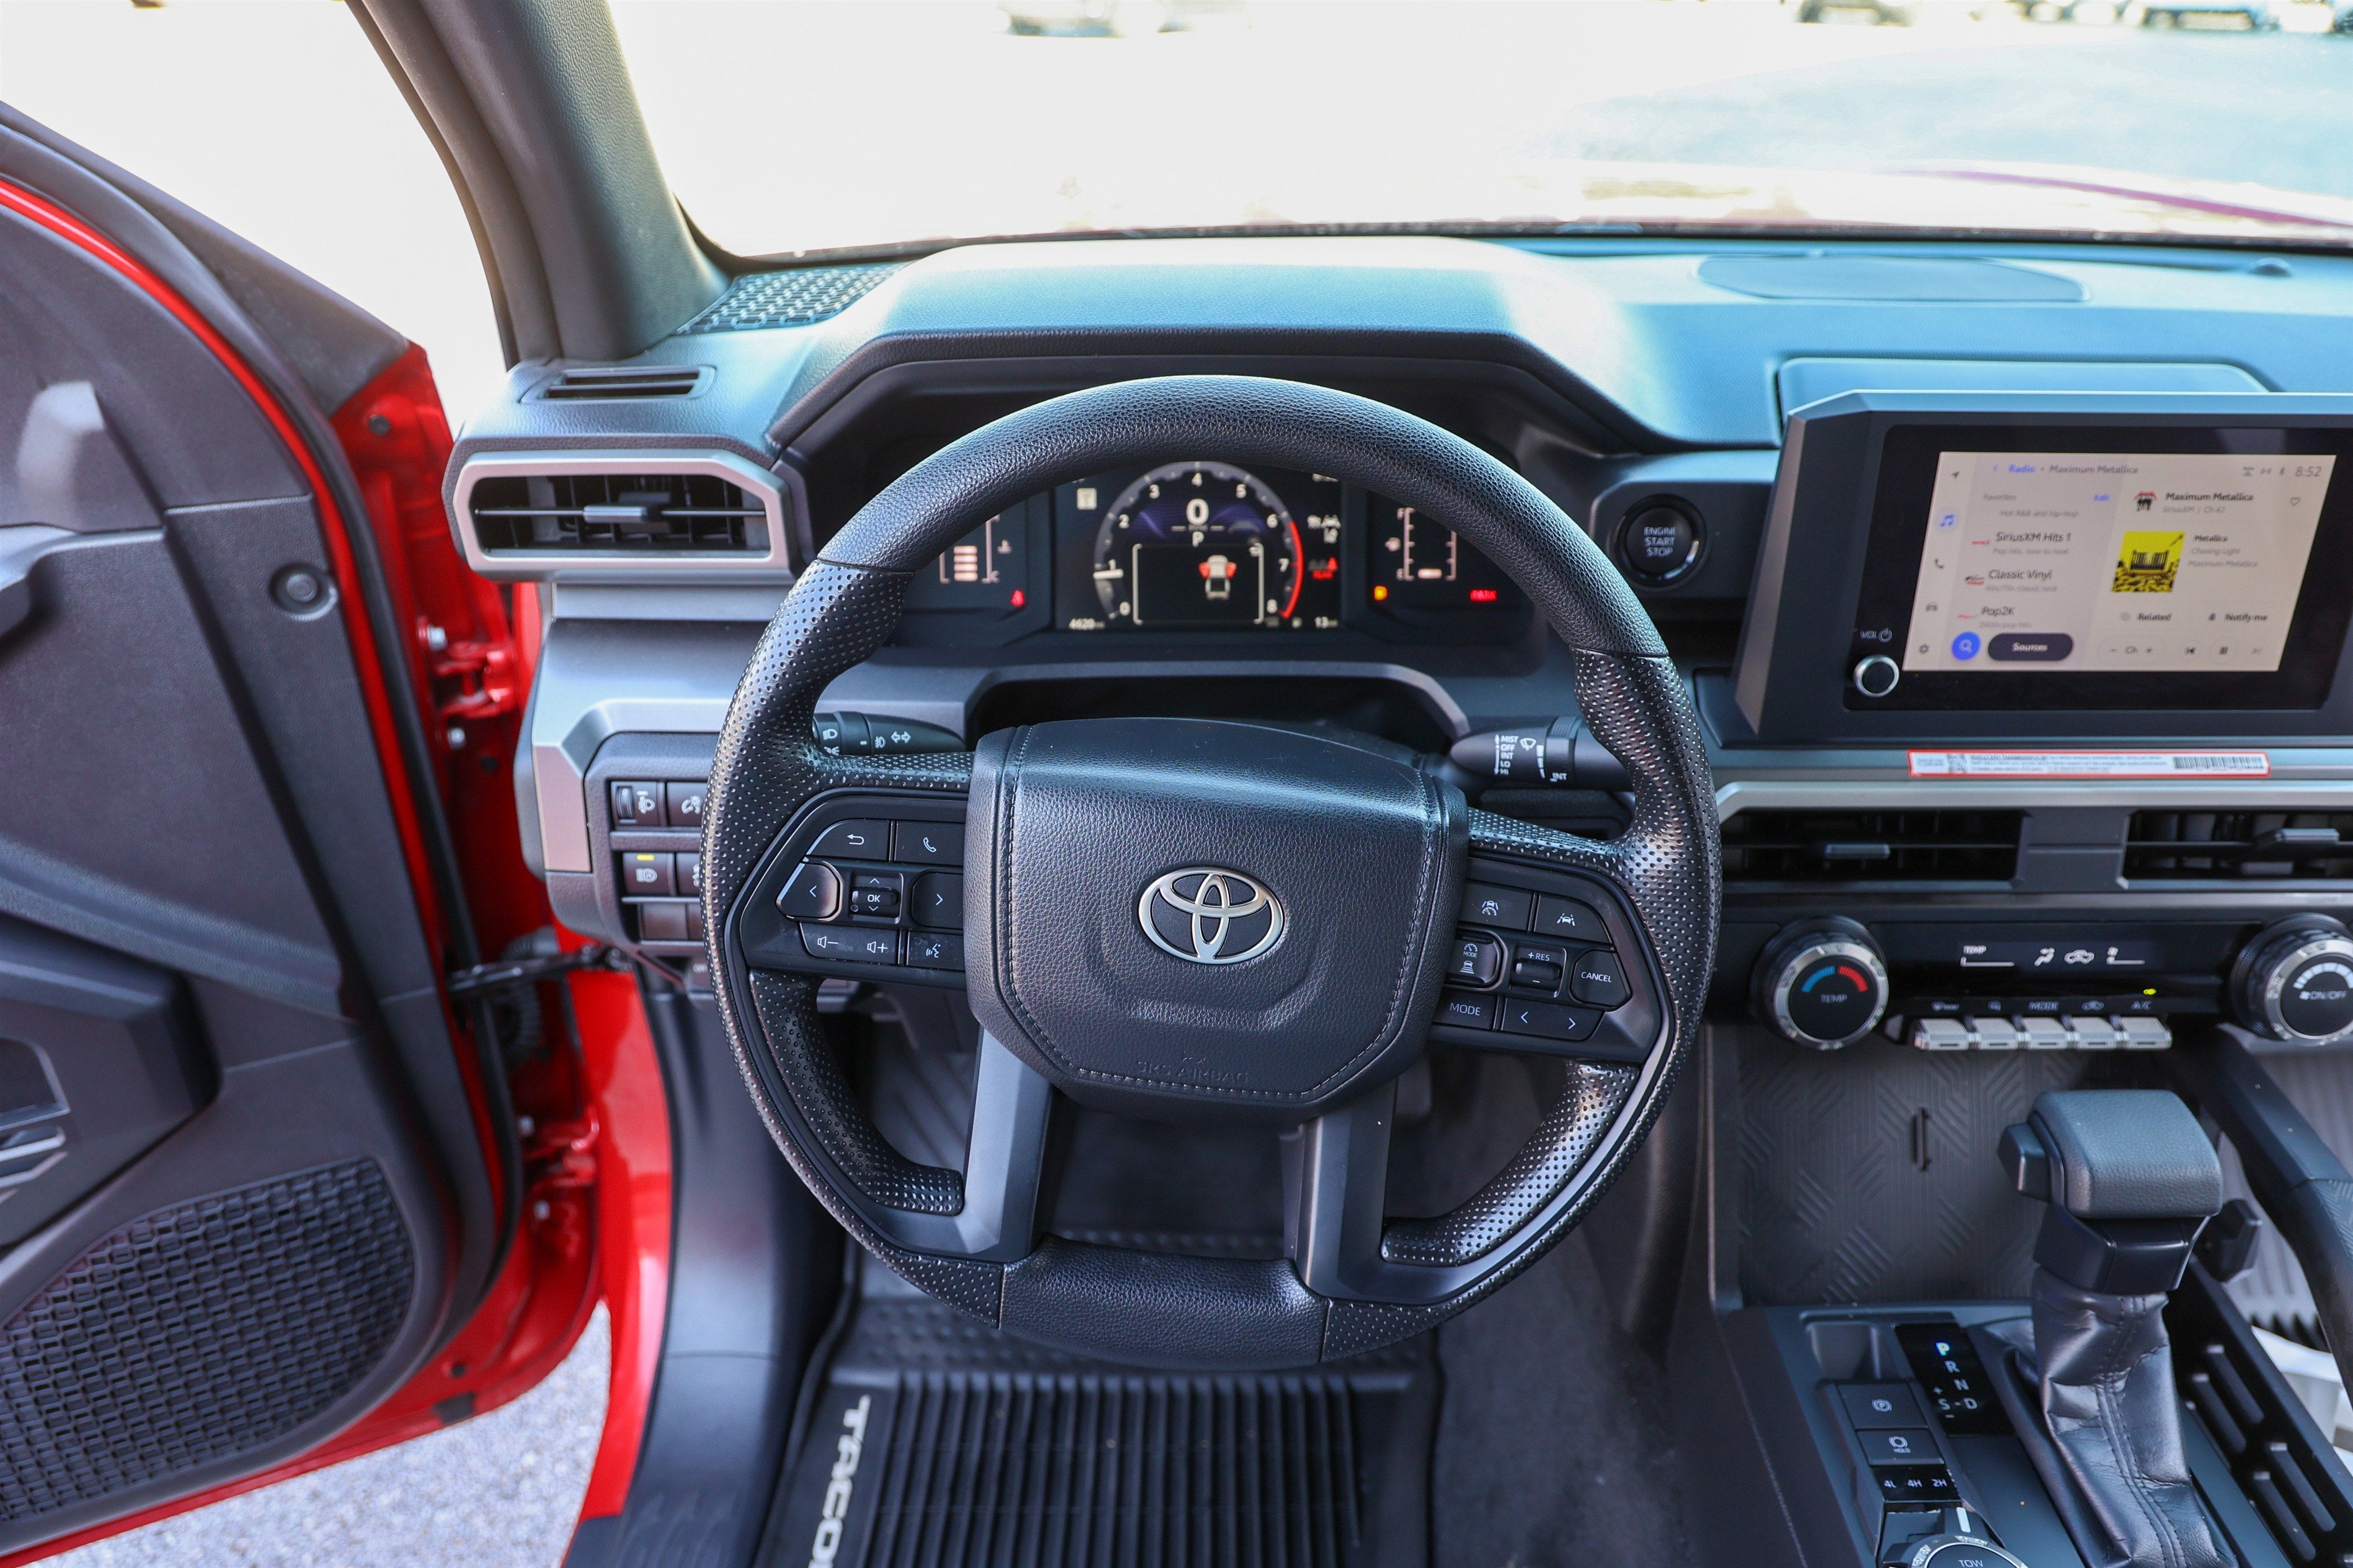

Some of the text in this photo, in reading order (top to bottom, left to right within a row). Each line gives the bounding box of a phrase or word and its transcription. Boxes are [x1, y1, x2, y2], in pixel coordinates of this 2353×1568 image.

[2008, 465, 2139, 474] Radio Maximum Metallica
[2295, 466, 2323, 477] 8:52
[1191, 472, 1203, 487] 4
[1149, 484, 1160, 499] 3
[1236, 484, 1247, 499] 5
[2165, 492, 2254, 501] Maximum Metallica
[1186, 498, 1209, 526] 0
[1118, 513, 1130, 529] 2
[1266, 513, 1278, 529] 6
[1644, 527, 1677, 536] ENGINE
[1996, 531, 2040, 542] SiriusXM
[2044, 532, 2063, 542] Hits
[1191, 531, 1205, 547] P
[1644, 536, 1675, 546] START
[1646, 547, 1673, 557] STOP
[1279, 558, 1290, 573] 7
[1988, 569, 2053, 581] Classic Vinyl
[1119, 601, 1131, 616] 0
[1982, 606, 2015, 617] Pop2K
[2138, 613, 2171, 621] Related
[2224, 613, 2251, 623] Notify
[2012, 642, 2049, 652] Sources
[1500, 735, 1519, 743] MIST
[1500, 744, 1515, 752] OFF
[1500, 752, 1514, 760] INT
[1552, 772, 1568, 781] INT
[867, 894, 881, 903] OK
[1963, 945, 1987, 955] TEMP
[1580, 971, 1613, 983] CANCEL
[1449, 1002, 1482, 1017] MODE
[1935, 1342, 1950, 1356] P
[1944, 1360, 1961, 1373] R
[1953, 1378, 1969, 1391] N
[1938, 1397, 1978, 1410] S D
[1883, 1478, 1947, 1488] 4L 4H 2H
[1958, 1559, 1984, 1568] TOW
